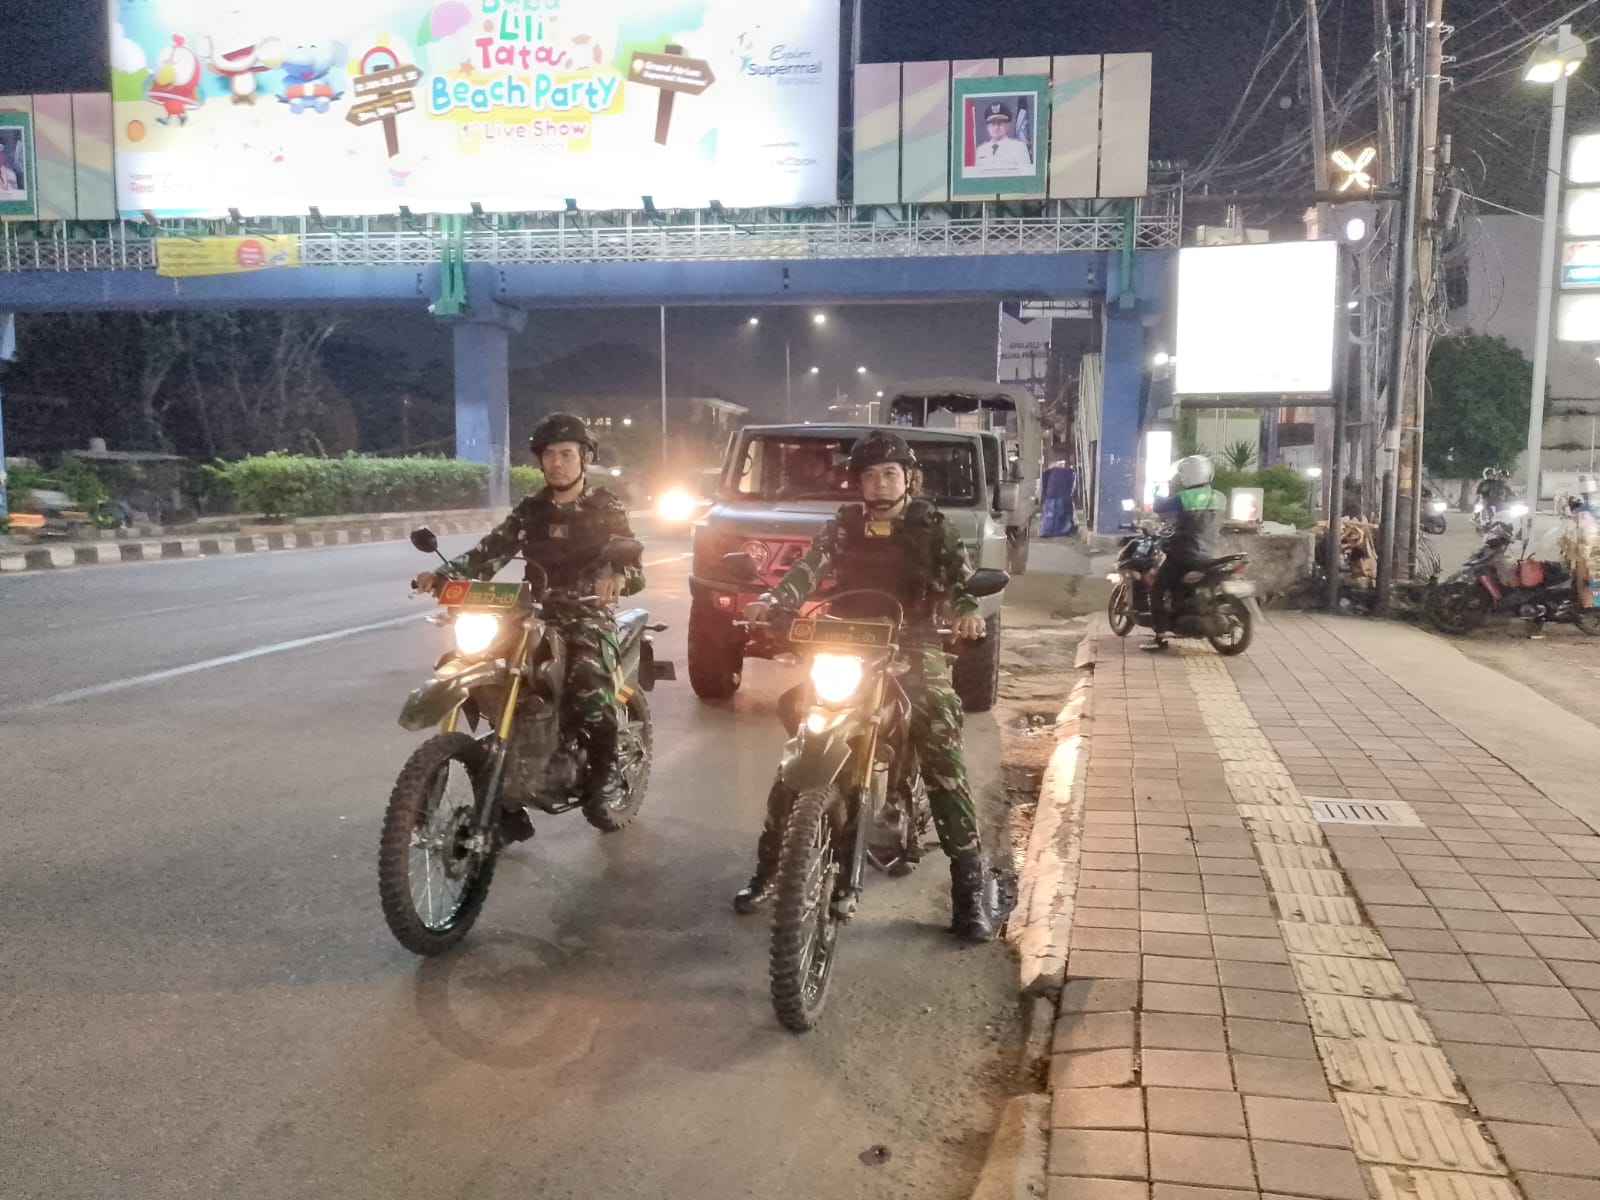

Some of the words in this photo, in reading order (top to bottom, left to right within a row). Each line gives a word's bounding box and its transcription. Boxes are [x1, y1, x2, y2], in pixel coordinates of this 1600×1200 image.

[500, 9, 543, 42] Lili
[475, 37, 567, 70] Tata
[432, 75, 525, 111] Beach
[535, 73, 616, 109] Party
[485, 121, 526, 139] Live
[533, 120, 587, 137] Show
